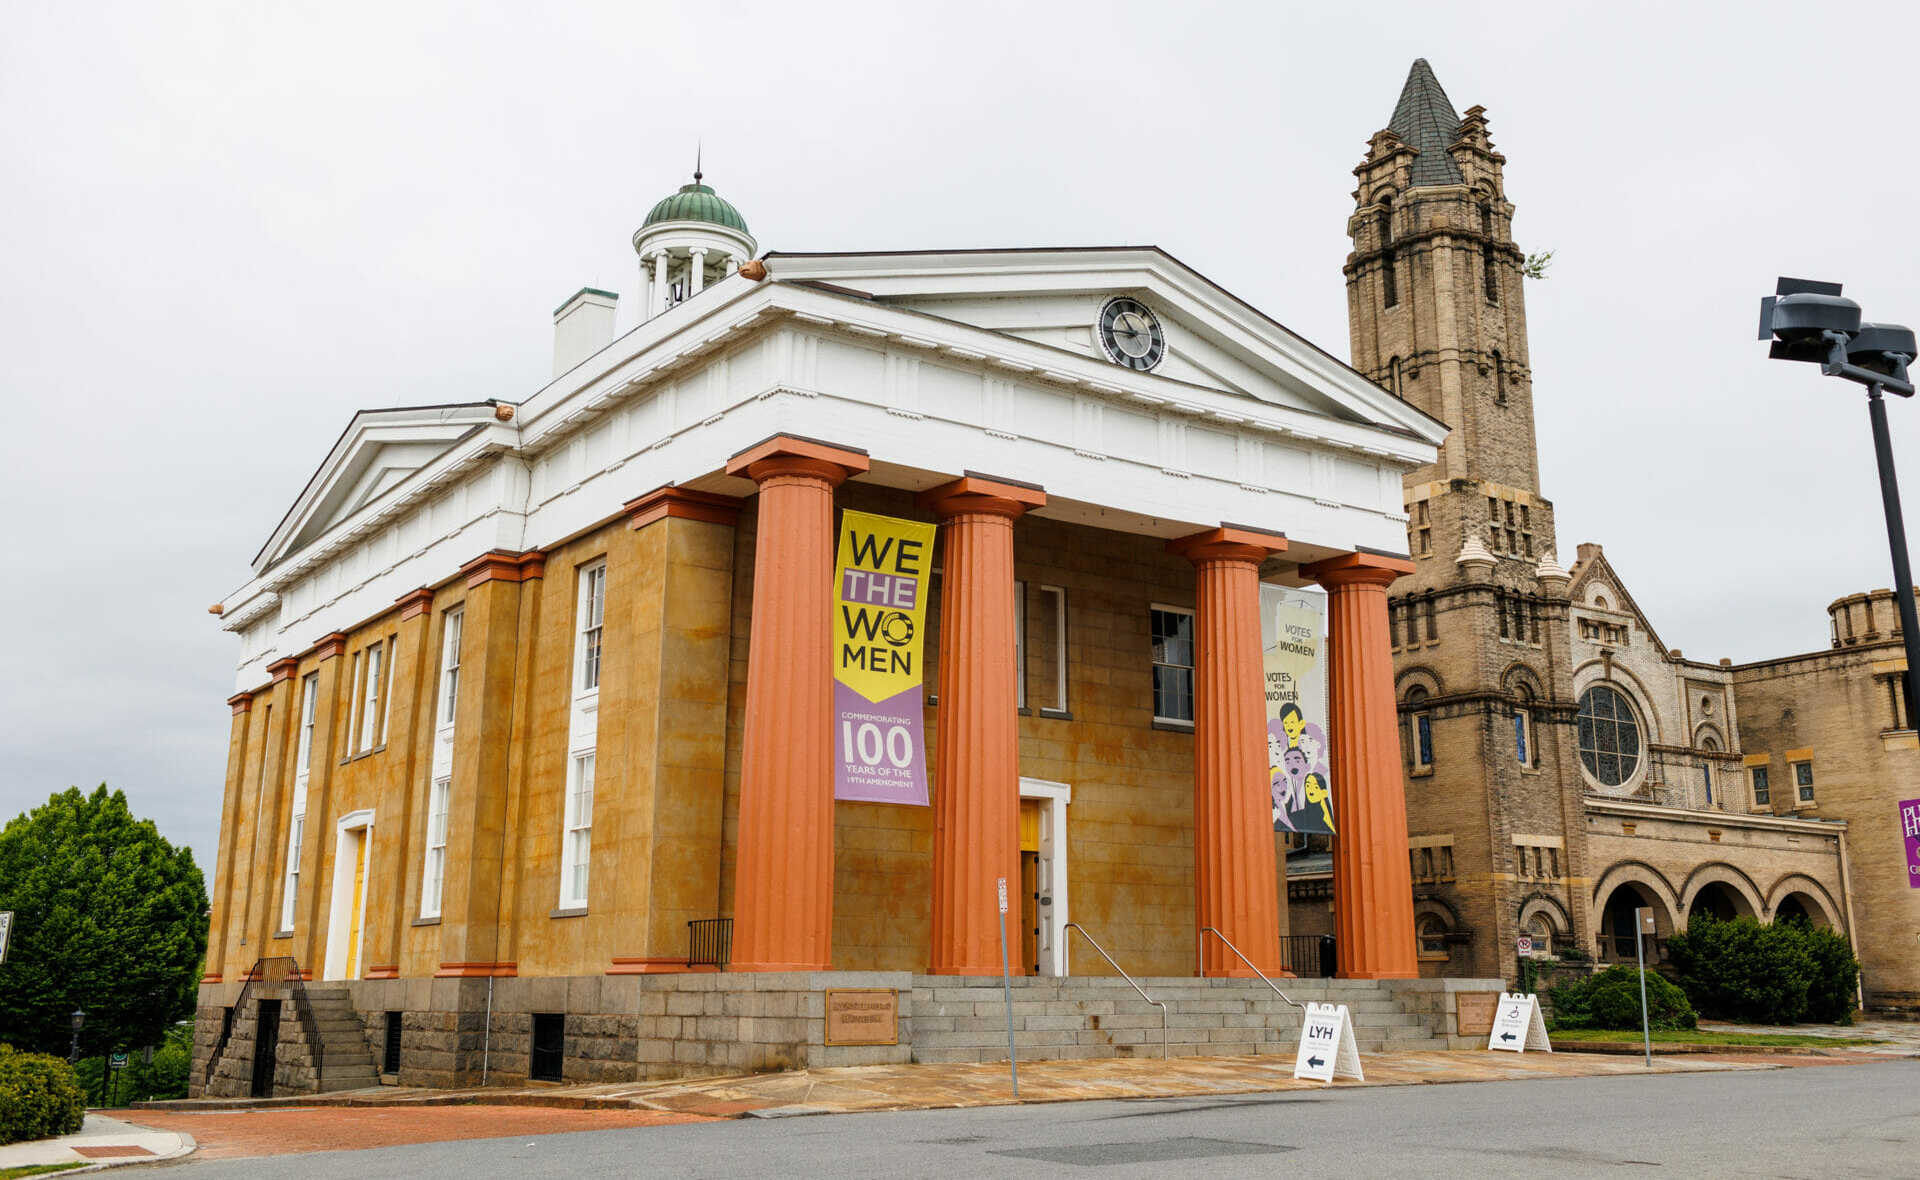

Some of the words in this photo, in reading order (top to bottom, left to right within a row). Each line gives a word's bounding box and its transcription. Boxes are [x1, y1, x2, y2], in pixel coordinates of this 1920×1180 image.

[850, 530, 923, 575] WE
[845, 570, 916, 608] THE
[1285, 624, 1311, 638] VOTES
[1280, 641, 1315, 657] WOMEN
[842, 643, 911, 675] MEN
[1266, 672, 1292, 682] VOTES
[1265, 691, 1299, 701] WOMEN
[841, 711, 912, 725] COMMEMORATING
[843, 720, 913, 768] 100
[846, 764, 876, 775] YEARS
[878, 767, 891, 776] OF
[892, 768, 912, 778] THE
[1309, 1026, 1333, 1040] LYH
